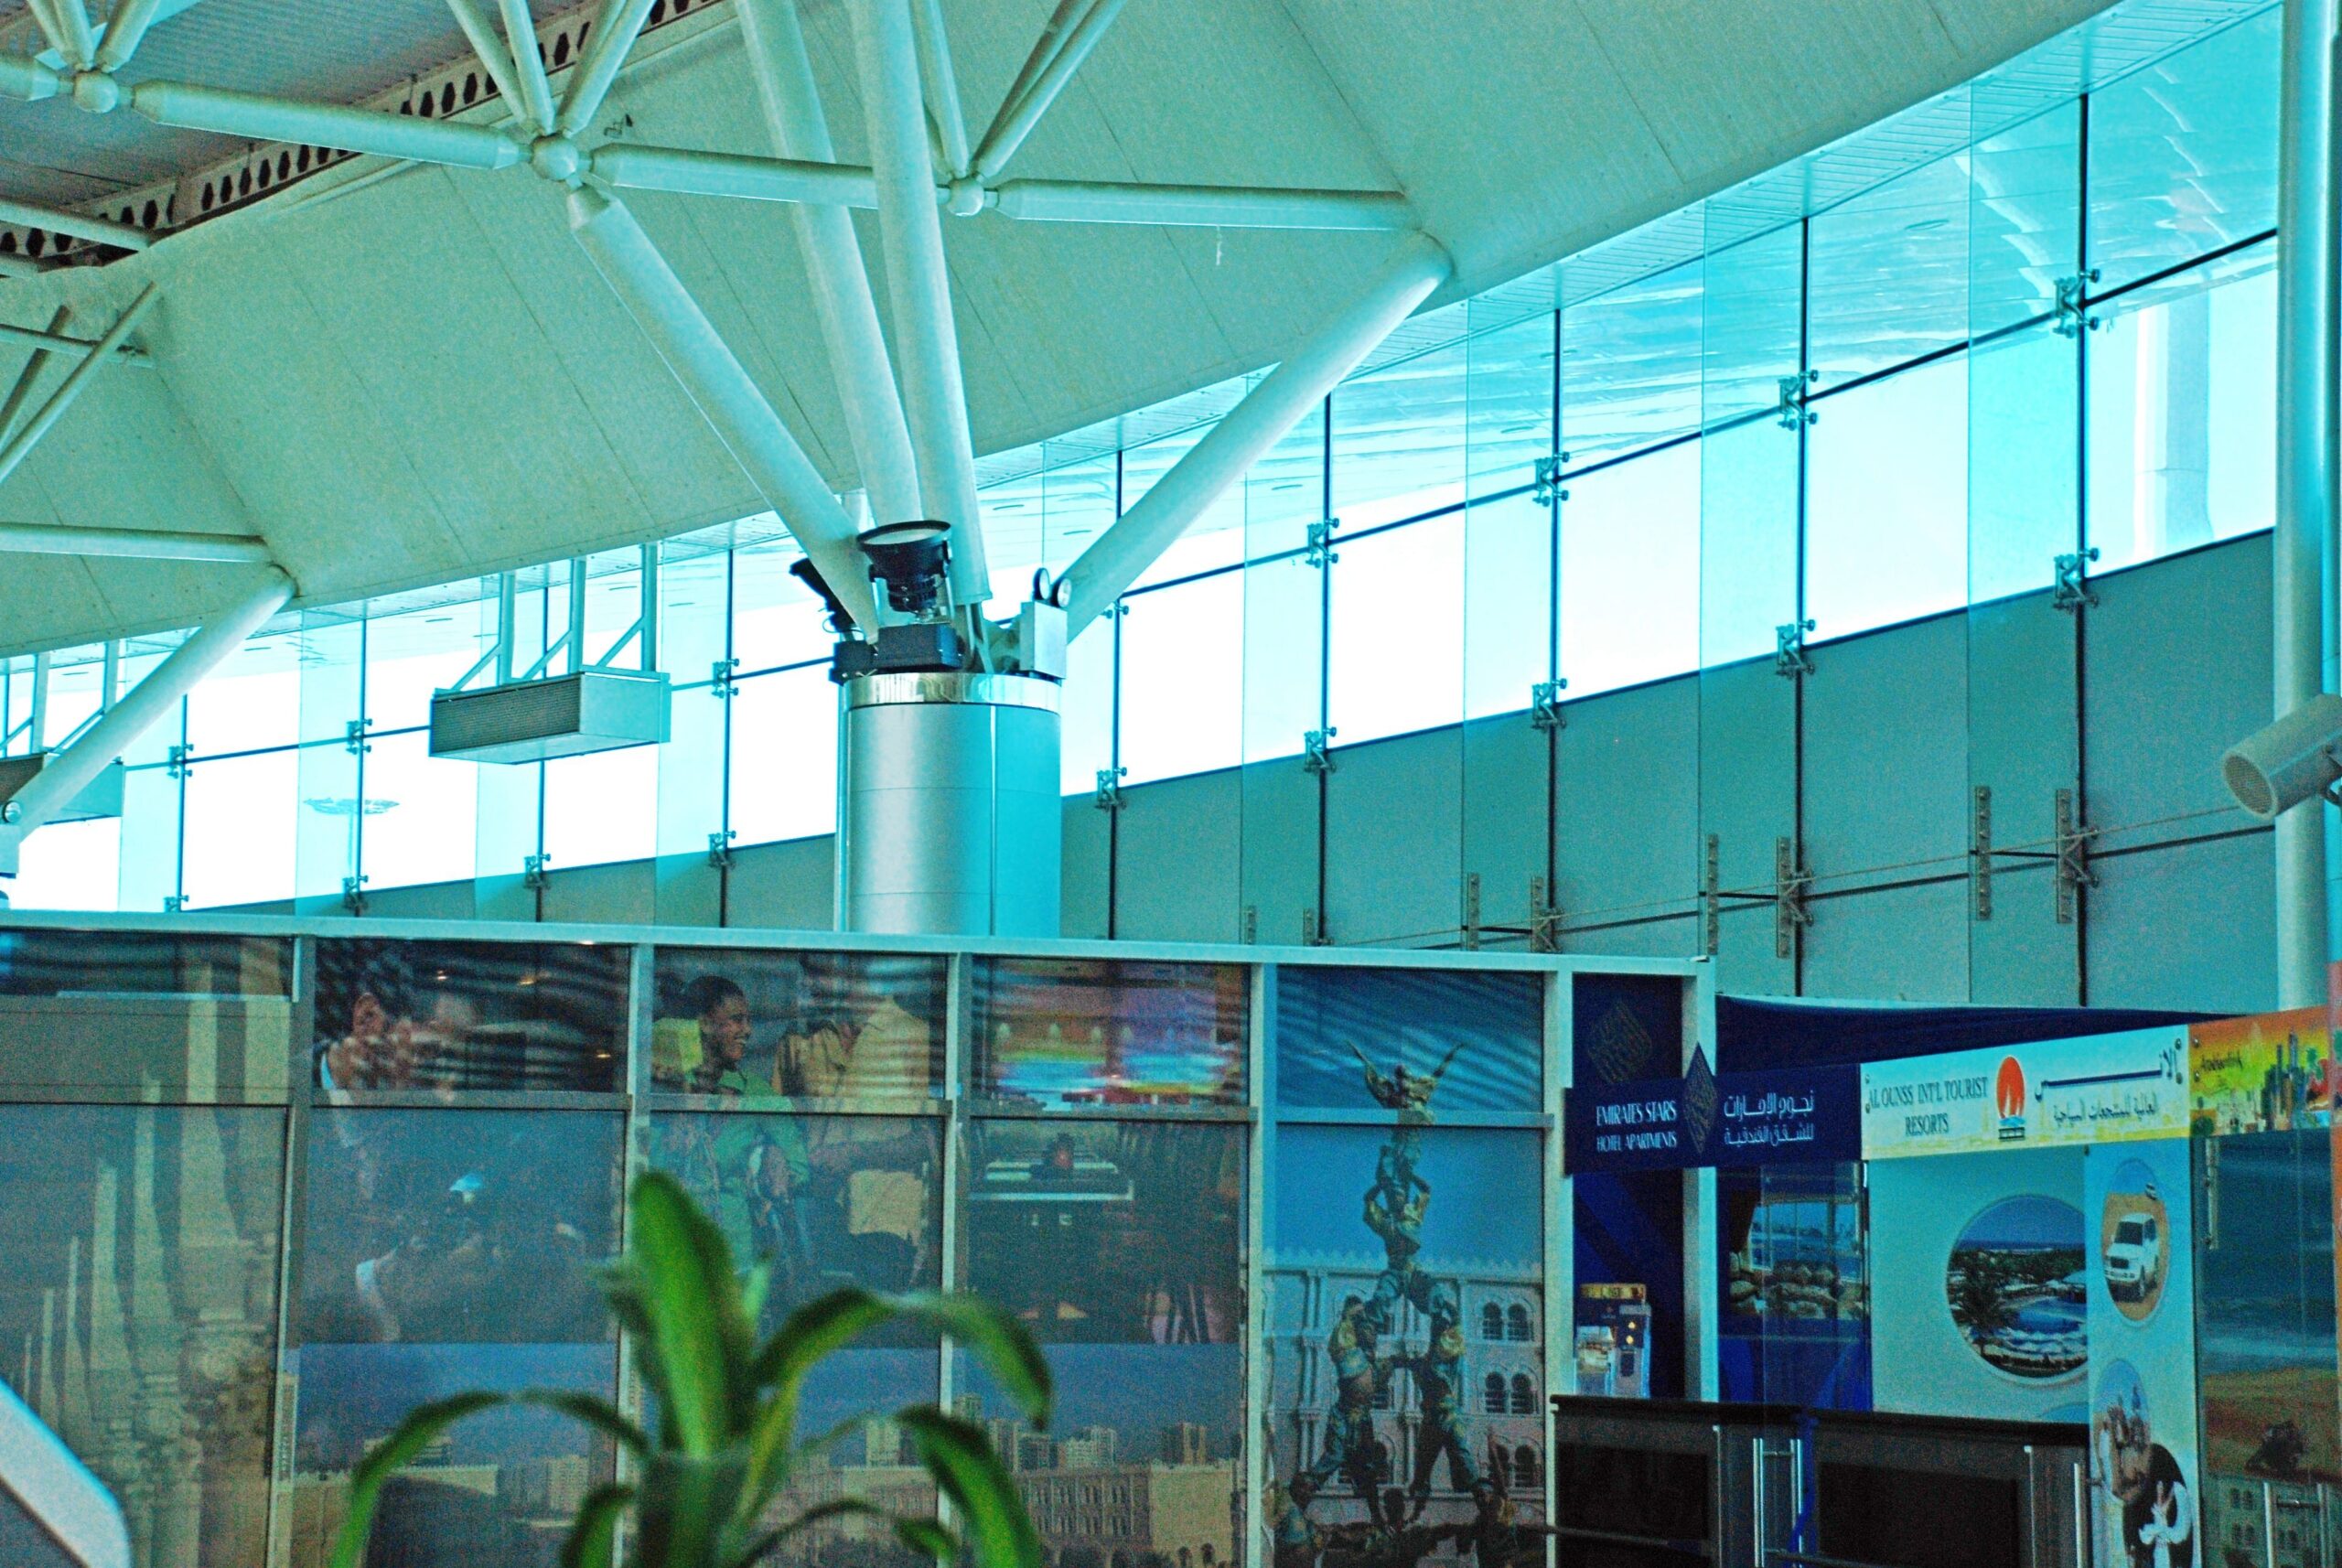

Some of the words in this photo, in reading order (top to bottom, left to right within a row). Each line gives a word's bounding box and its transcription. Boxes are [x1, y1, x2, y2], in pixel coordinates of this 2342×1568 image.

[1943, 1076, 1989, 1101] TOURIST
[1595, 1103, 1643, 1127] EMIRATES
[1645, 1101, 1677, 1123] STARS
[1778, 1090, 1815, 1121] نجوم
[1905, 1112, 1950, 1137] RESORTS
[1596, 1134, 1622, 1153] HOTEL
[1625, 1131, 1677, 1151] APARTMENTS
